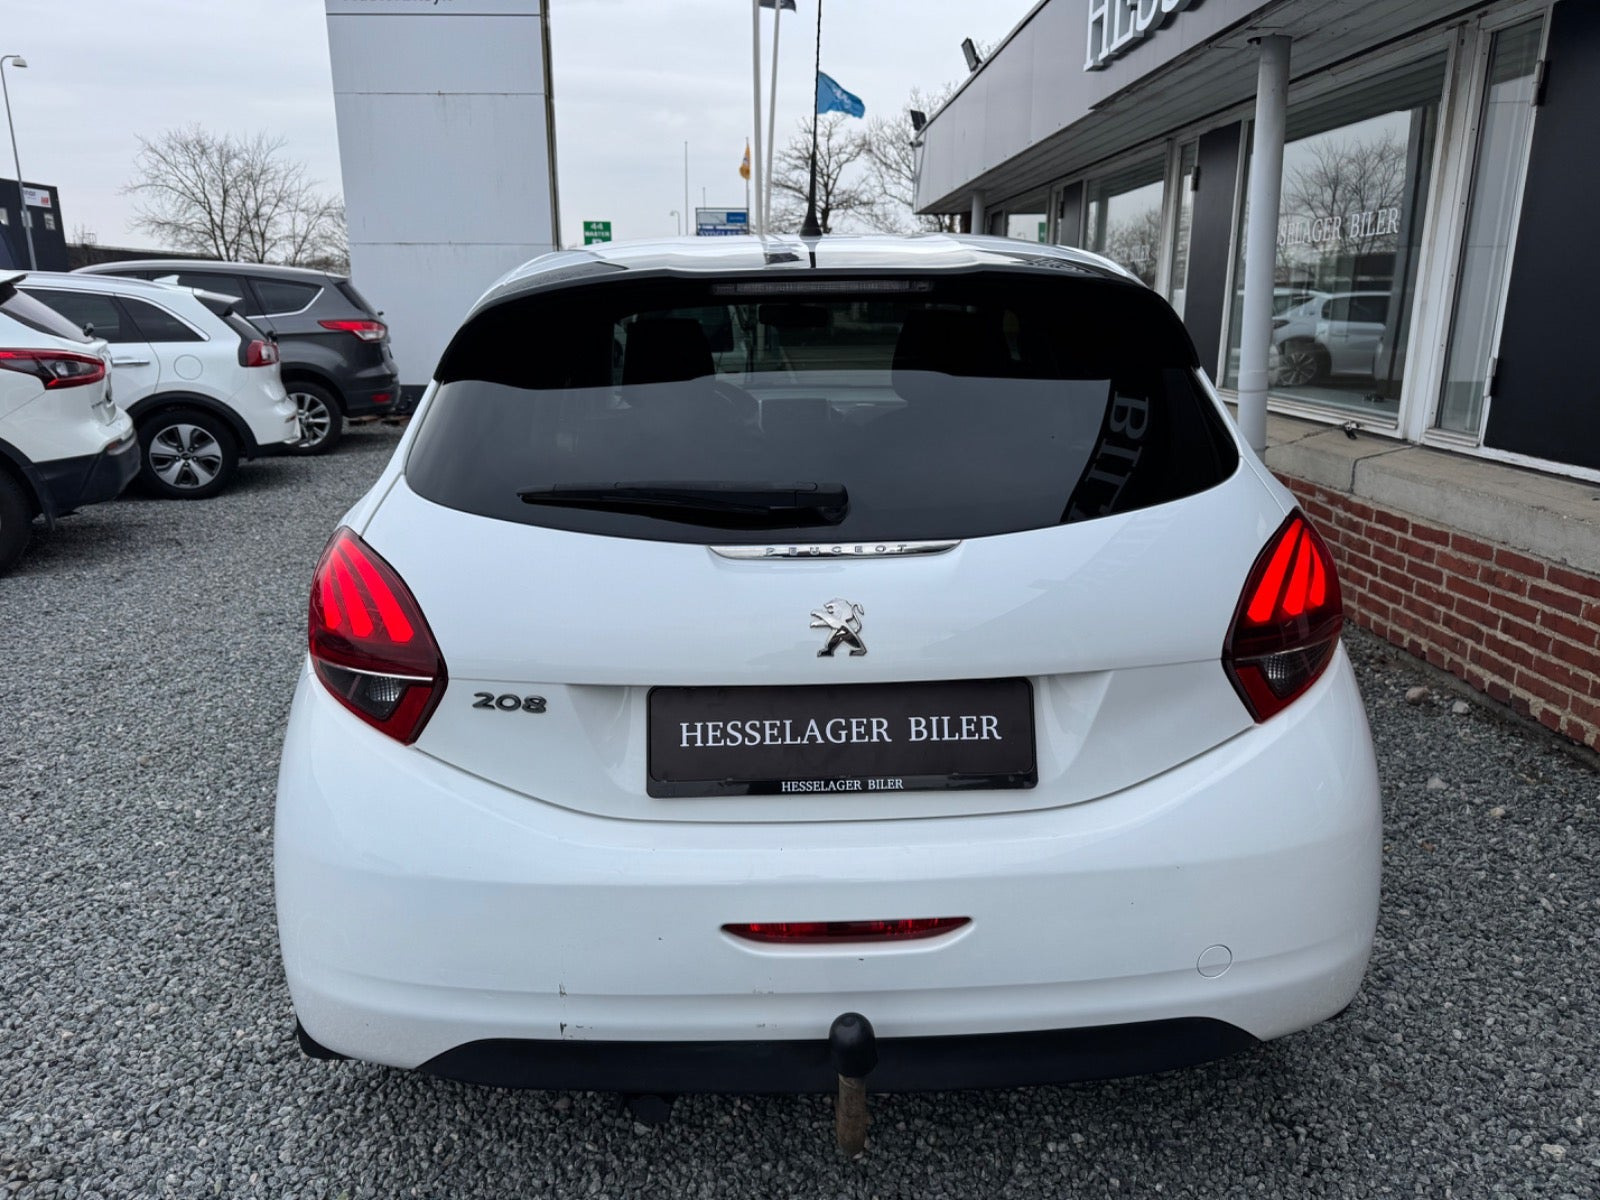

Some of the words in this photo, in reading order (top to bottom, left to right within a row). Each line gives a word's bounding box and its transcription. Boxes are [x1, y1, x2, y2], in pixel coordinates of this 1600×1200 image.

[1277, 216, 1342, 246] SELAGER
[1349, 207, 1399, 238] BILER
[765, 544, 907, 556] PEUGEOT
[472, 692, 547, 713] 208
[679, 717, 892, 747] HESSELAGER
[908, 715, 1002, 741] BILER
[781, 780, 862, 792] HESSELAGER
[868, 779, 904, 790] BILER
